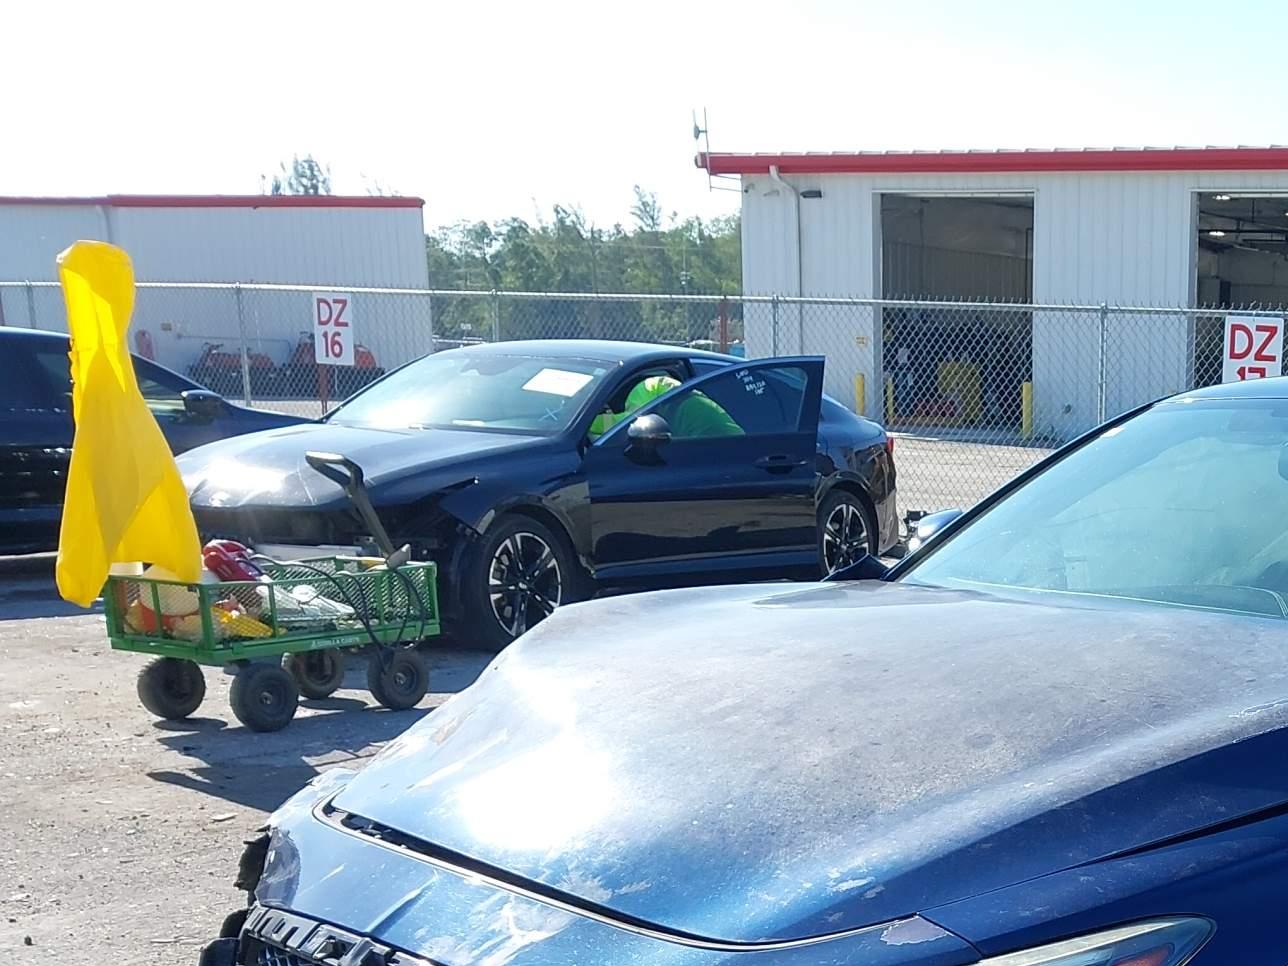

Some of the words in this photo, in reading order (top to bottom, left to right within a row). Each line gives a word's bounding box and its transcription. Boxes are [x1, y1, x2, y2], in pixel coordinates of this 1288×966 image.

[316, 297, 349, 327] DZ
[322, 330, 343, 358] 16
[1229, 323, 1278, 362] DZ
